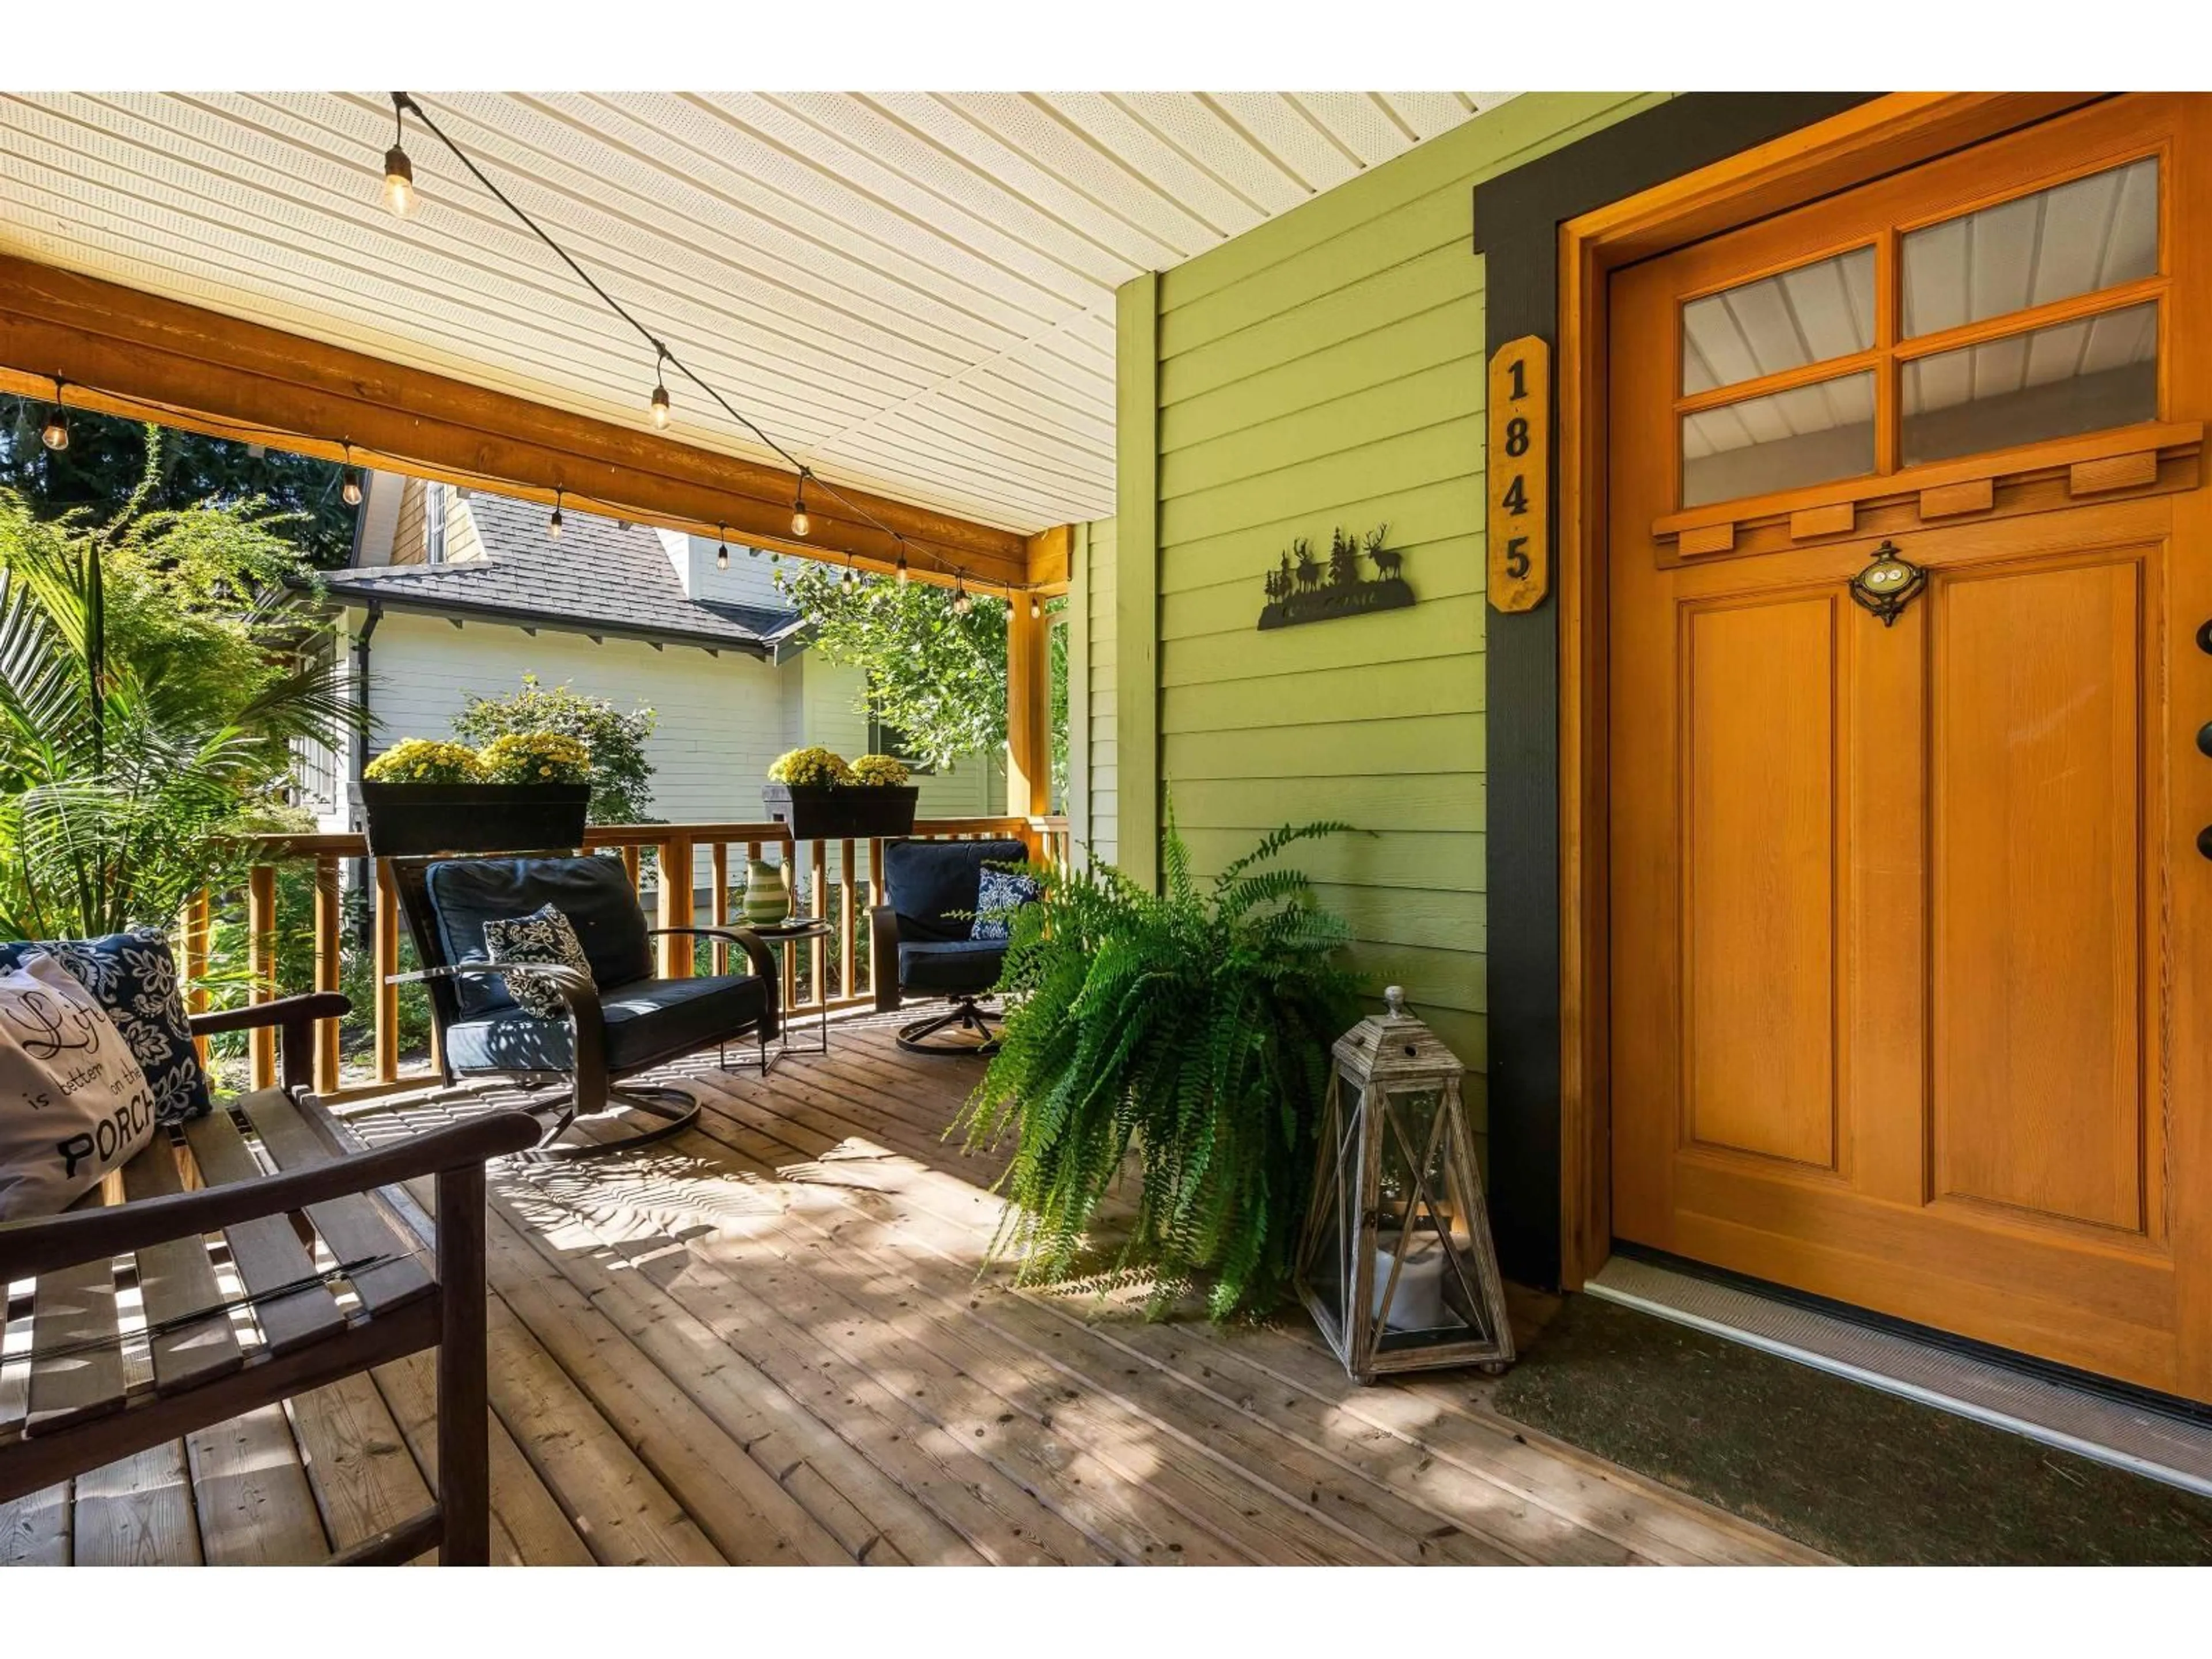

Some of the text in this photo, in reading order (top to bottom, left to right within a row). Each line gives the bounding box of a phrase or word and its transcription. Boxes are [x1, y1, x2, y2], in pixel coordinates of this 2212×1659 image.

[1502, 359, 1530, 580] 1845
[22, 1058, 142, 1110] is better on the
